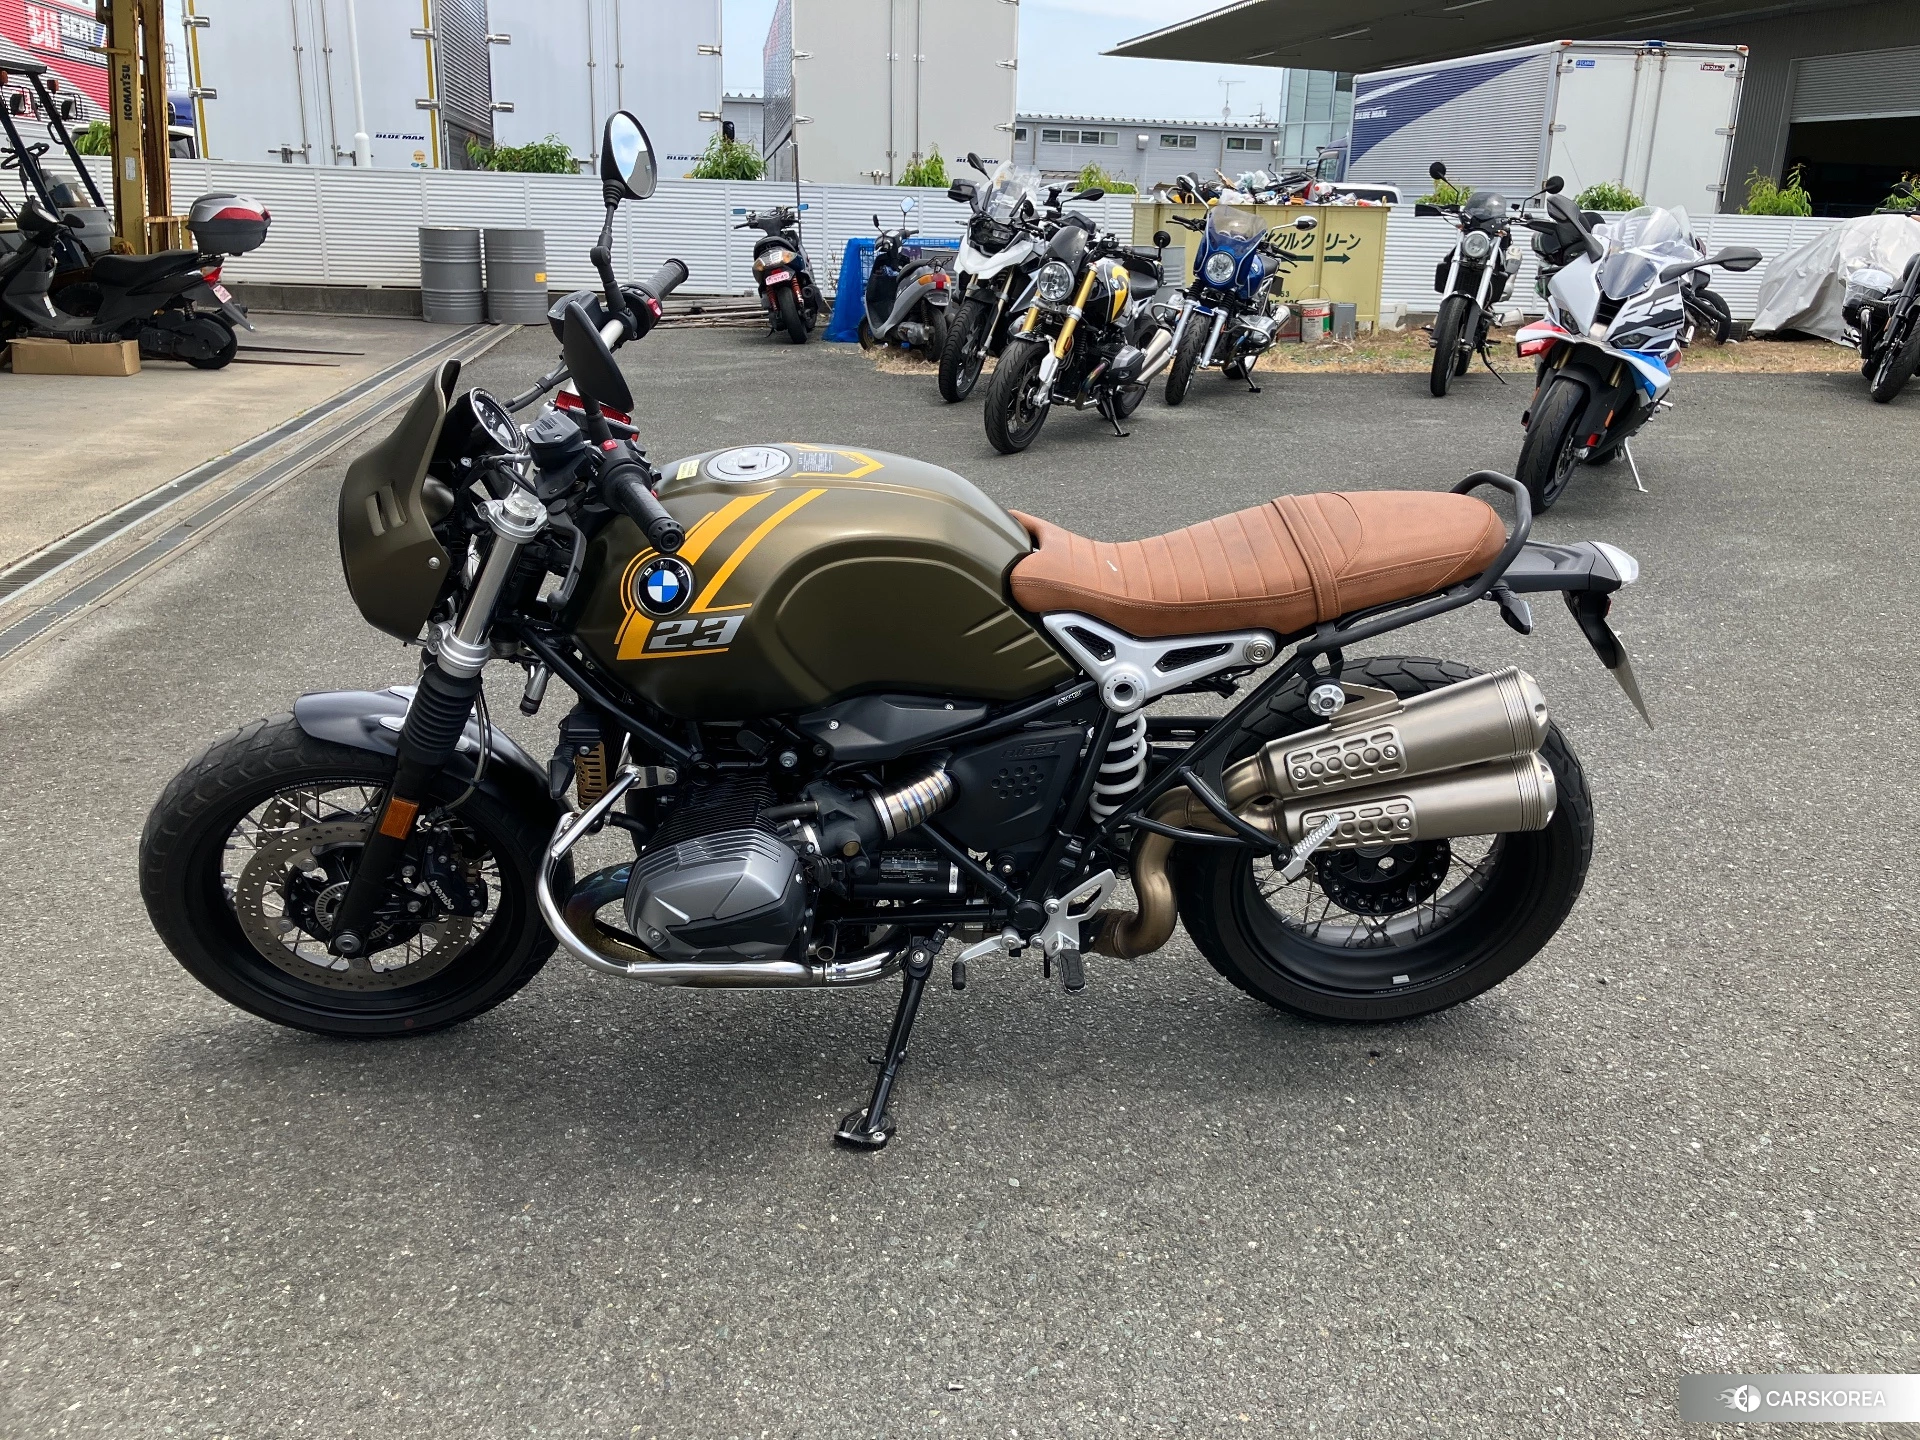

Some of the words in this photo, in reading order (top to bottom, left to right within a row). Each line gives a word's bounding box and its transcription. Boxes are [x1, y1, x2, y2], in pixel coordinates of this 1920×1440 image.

[120, 64, 132, 121] KOMATSU
[1302, 307, 1323, 316] Castrol
[643, 560, 686, 578] BMW
[648, 614, 746, 650] 23
[429, 879, 455, 910] brembo
